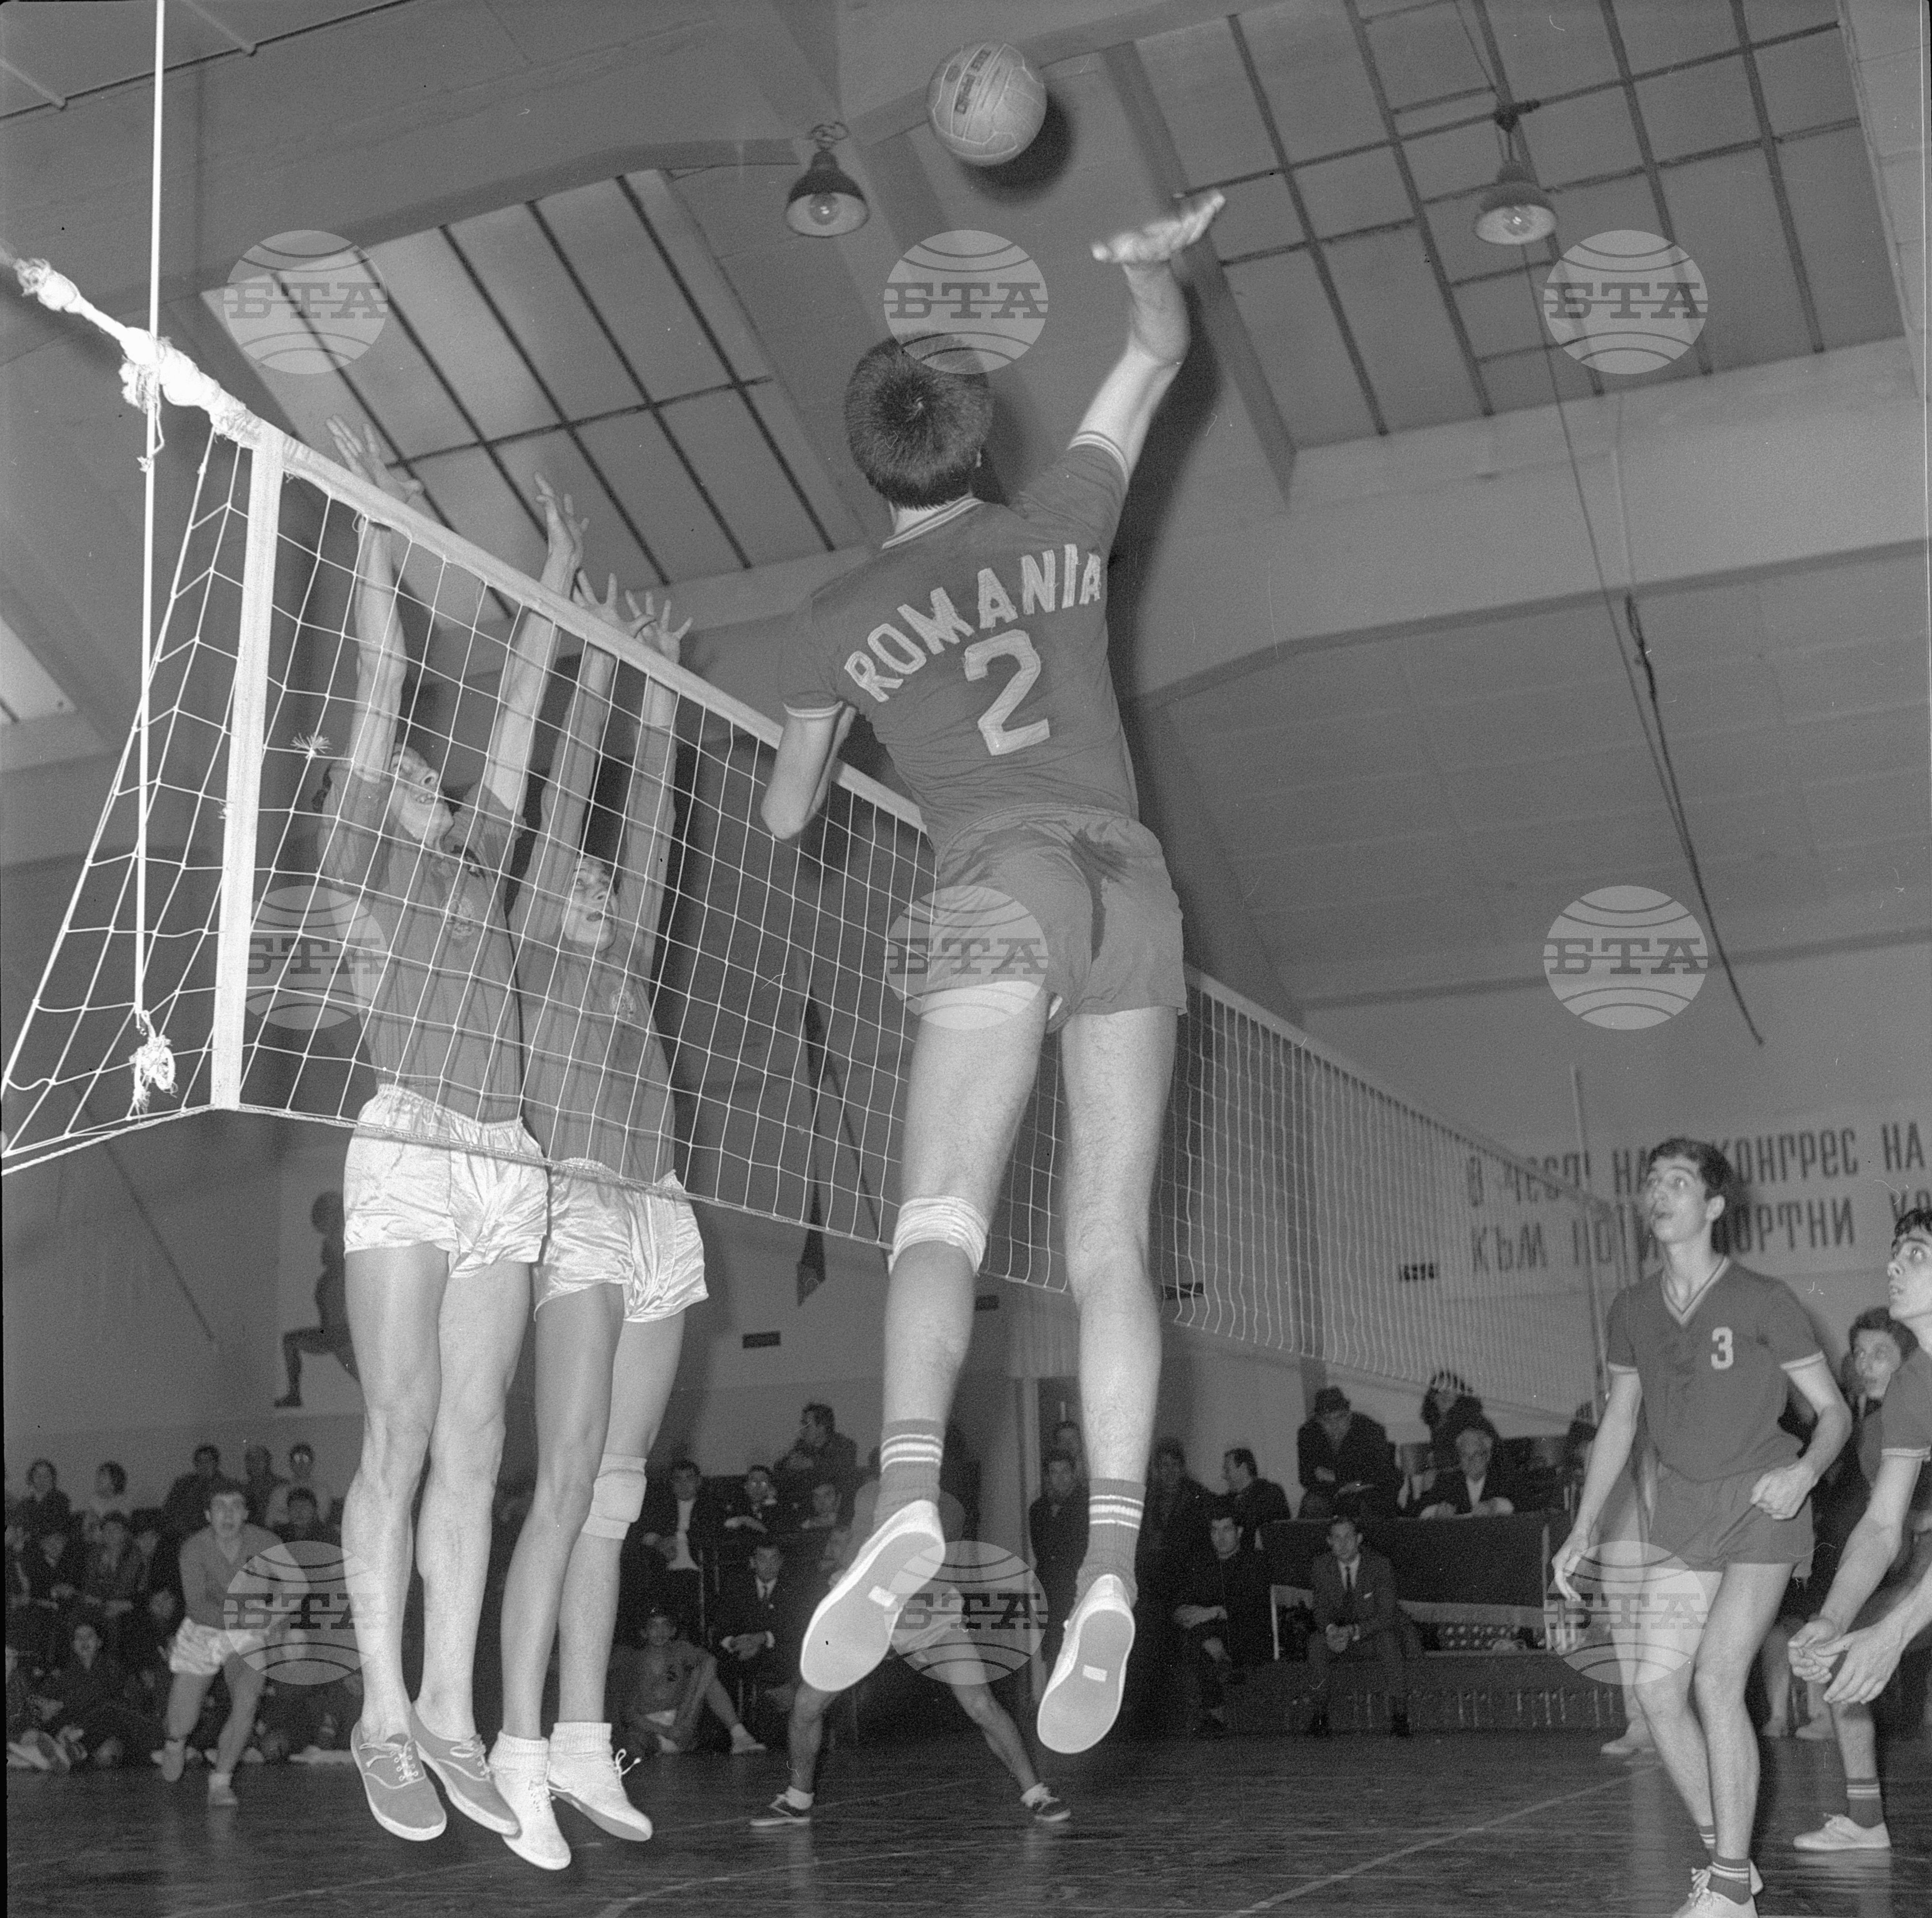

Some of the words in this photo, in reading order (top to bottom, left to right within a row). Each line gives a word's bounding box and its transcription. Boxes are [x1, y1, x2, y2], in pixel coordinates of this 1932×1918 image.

[844, 544, 1101, 702] ROMANIA
[964, 630, 1050, 756] 2
[1720, 1128, 1857, 1183] ОНГРЕС
[1882, 1122, 1925, 1170] НА
[1711, 1327, 1734, 1370] 3
